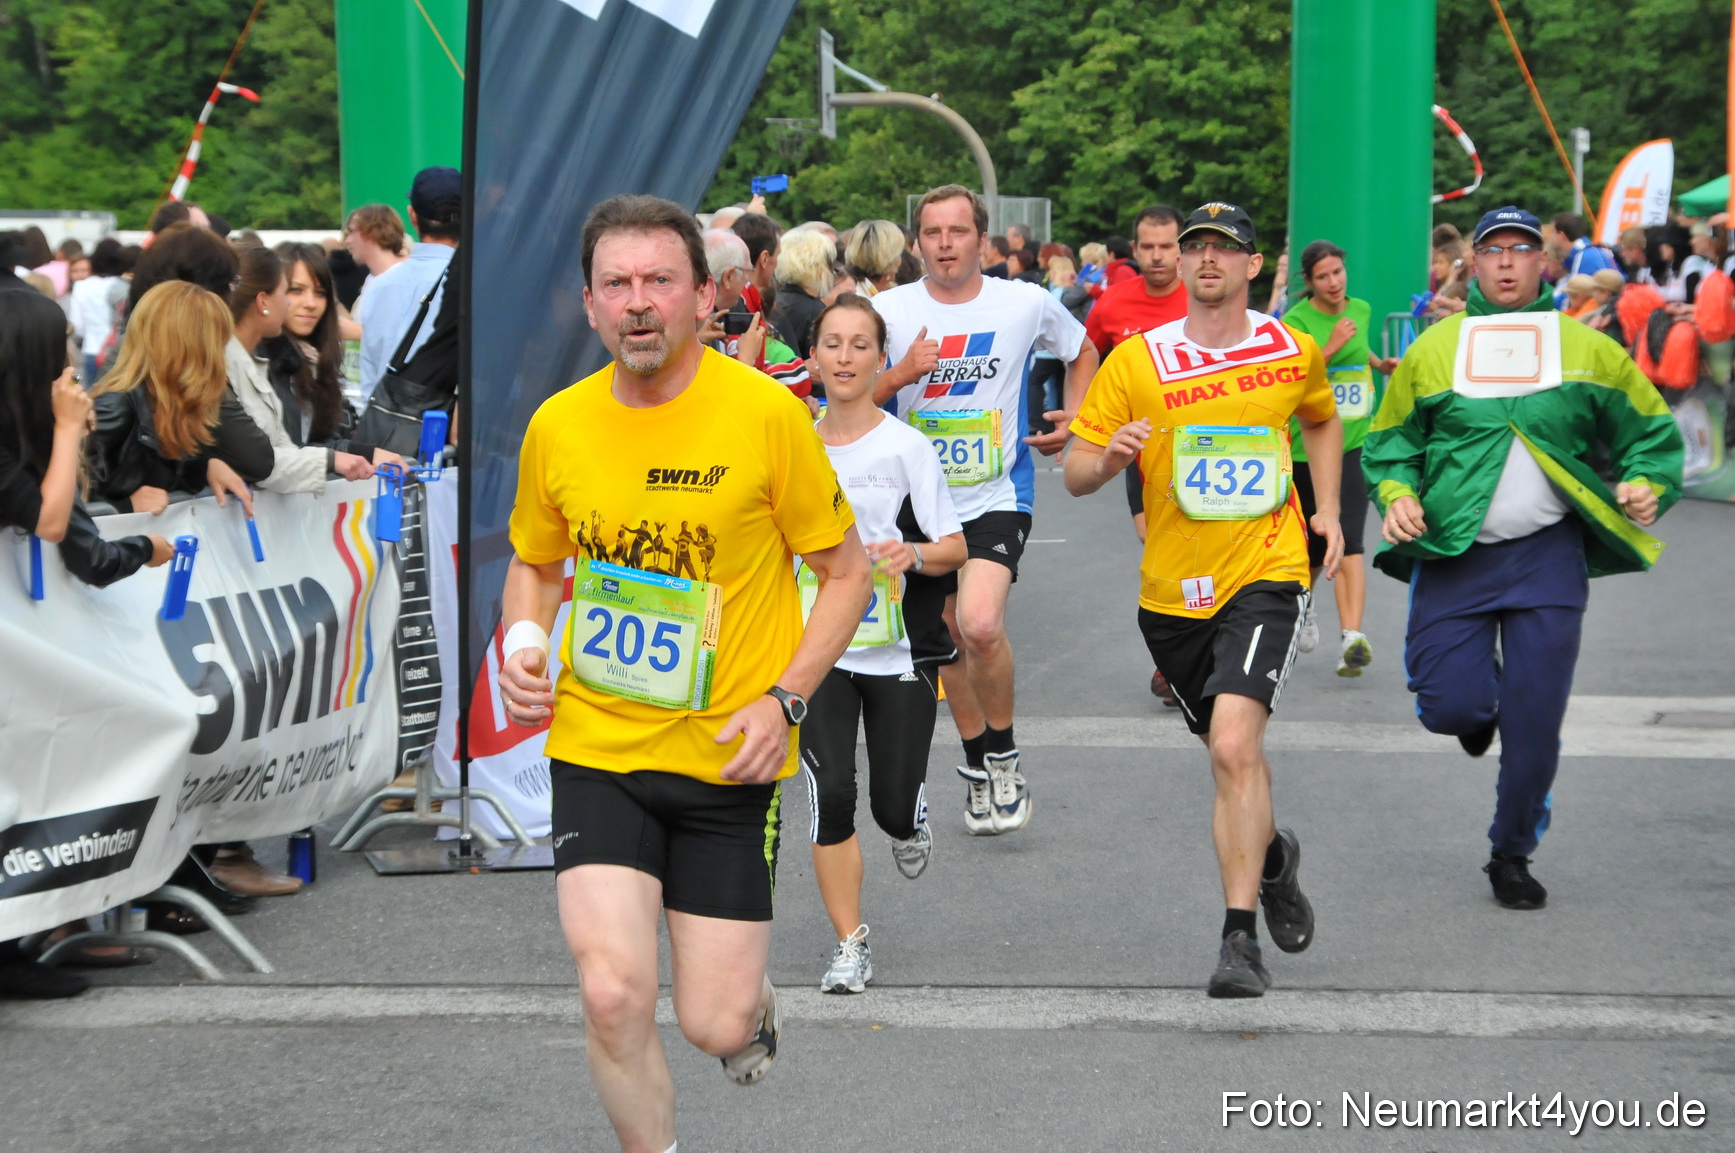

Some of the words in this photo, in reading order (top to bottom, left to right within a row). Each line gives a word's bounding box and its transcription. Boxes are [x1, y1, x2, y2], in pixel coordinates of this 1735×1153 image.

[1618, 172, 1650, 233] BL
[1163, 381, 1230, 410] MAX
[1236, 366, 1307, 392] BÖGL
[1331, 384, 1362, 405] 98
[932, 438, 984, 464] 261
[646, 468, 700, 485] swn
[1185, 458, 1265, 496] 432
[681, 486, 713, 494] neumarkt
[1202, 497, 1230, 506] Ralph
[591, 587, 635, 605] firmenlauf
[582, 607, 682, 673] 205
[157, 577, 339, 755] swn
[606, 663, 628, 678] Willi
[2, 847, 45, 876] die
[42, 828, 138, 868] verbinden
